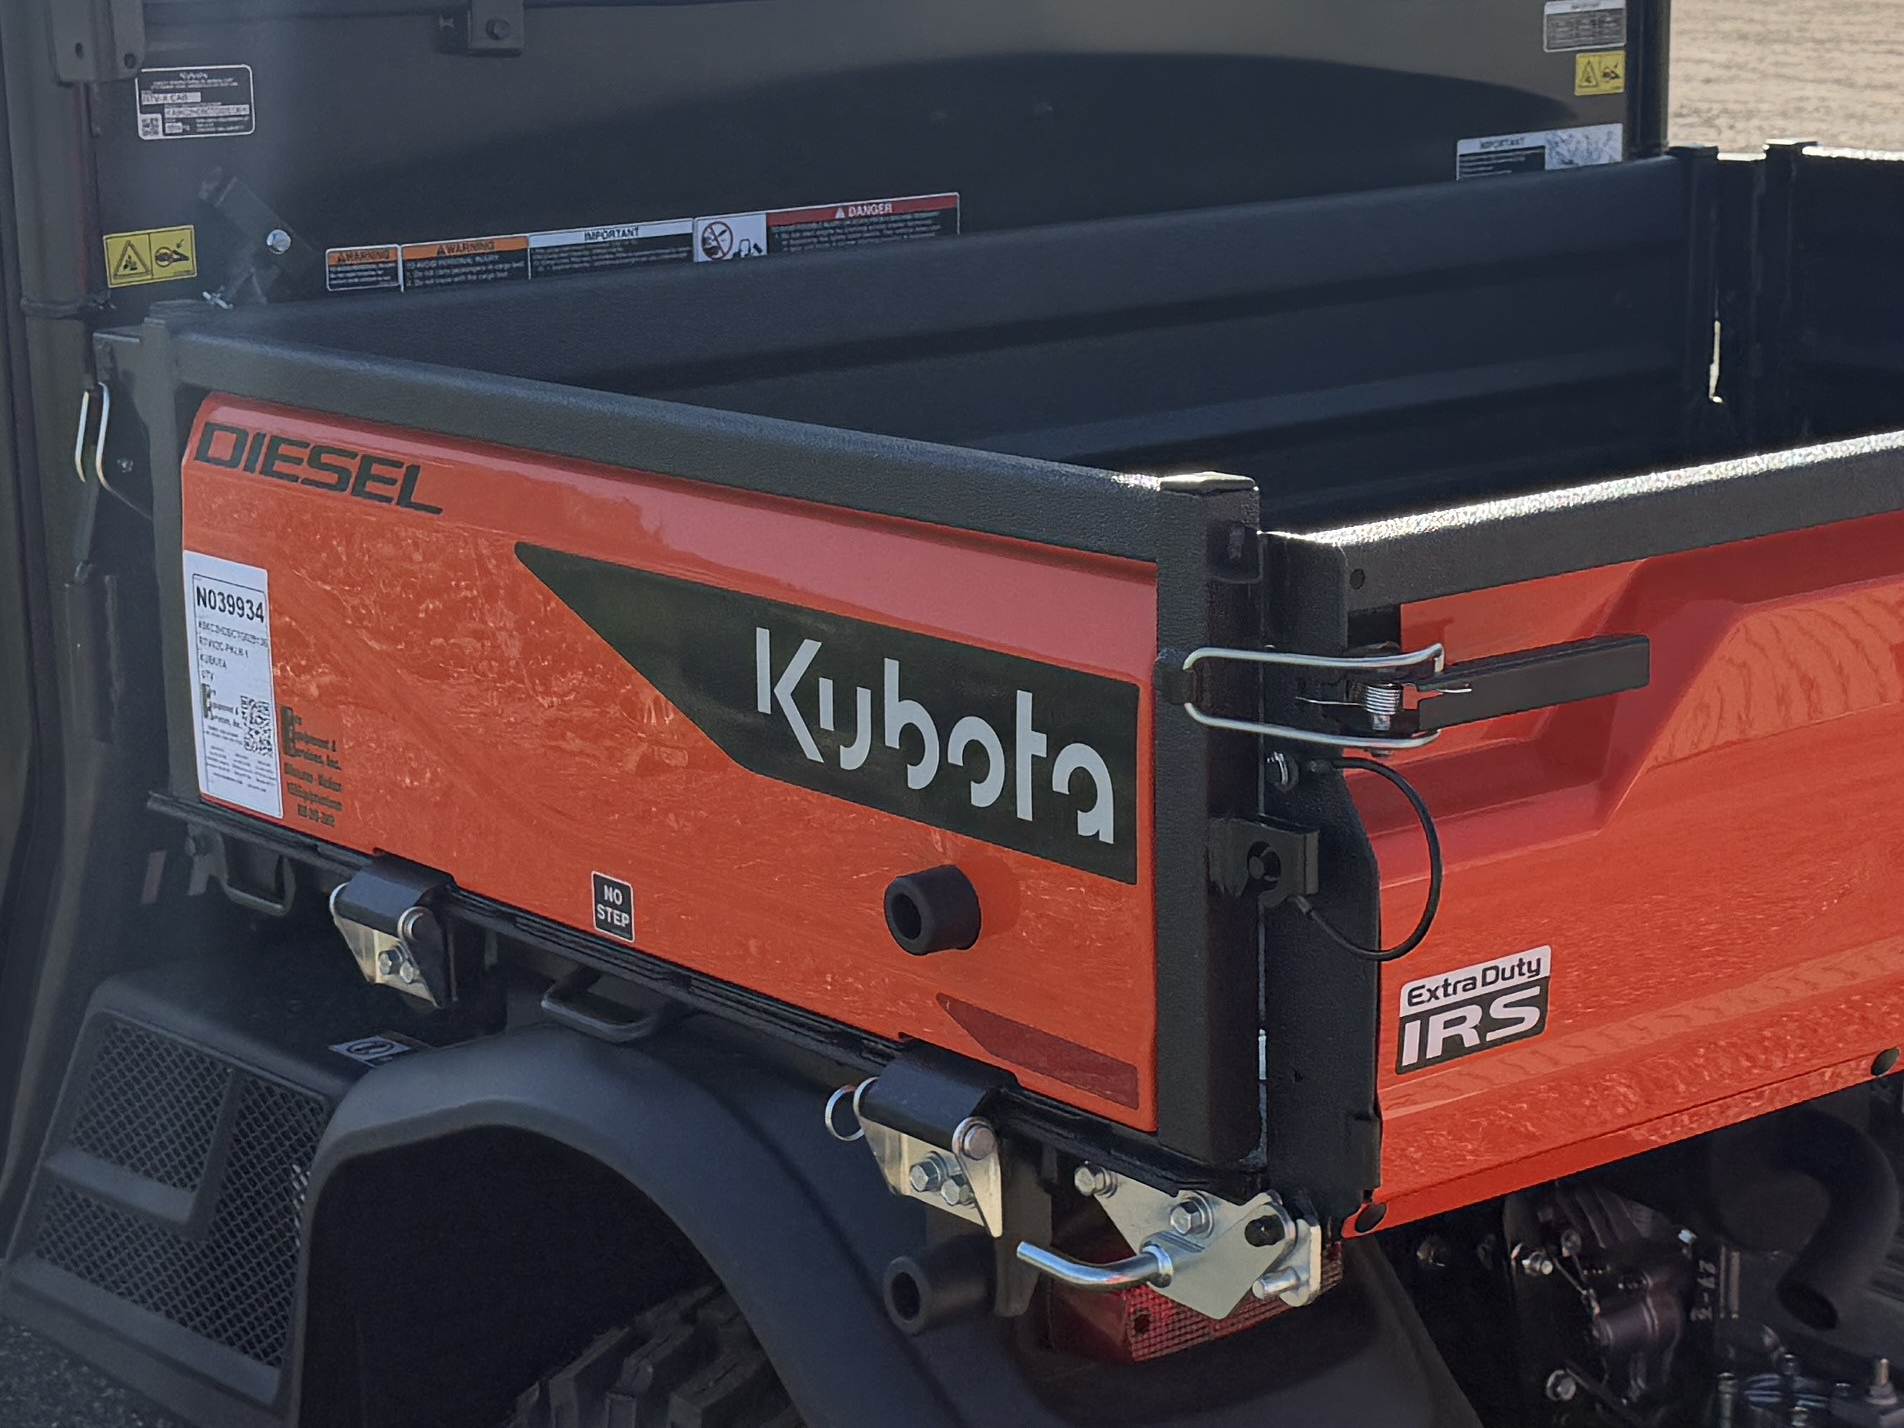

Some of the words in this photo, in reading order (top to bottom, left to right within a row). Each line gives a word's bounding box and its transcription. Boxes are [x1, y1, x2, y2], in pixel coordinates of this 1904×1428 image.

[847, 202, 894, 218] DANGER
[445, 240, 495, 256] WARNING
[583, 226, 640, 242] IMPORTANT
[193, 421, 444, 515] DIESEL
[195, 585, 265, 624] N039934
[756, 626, 1114, 845] Kubota
[603, 884, 623, 905] NO
[596, 903, 630, 928] STEP
[1407, 976, 1477, 1007] Extra
[1481, 957, 1541, 988] Duty
[1401, 985, 1541, 1067] IRS
